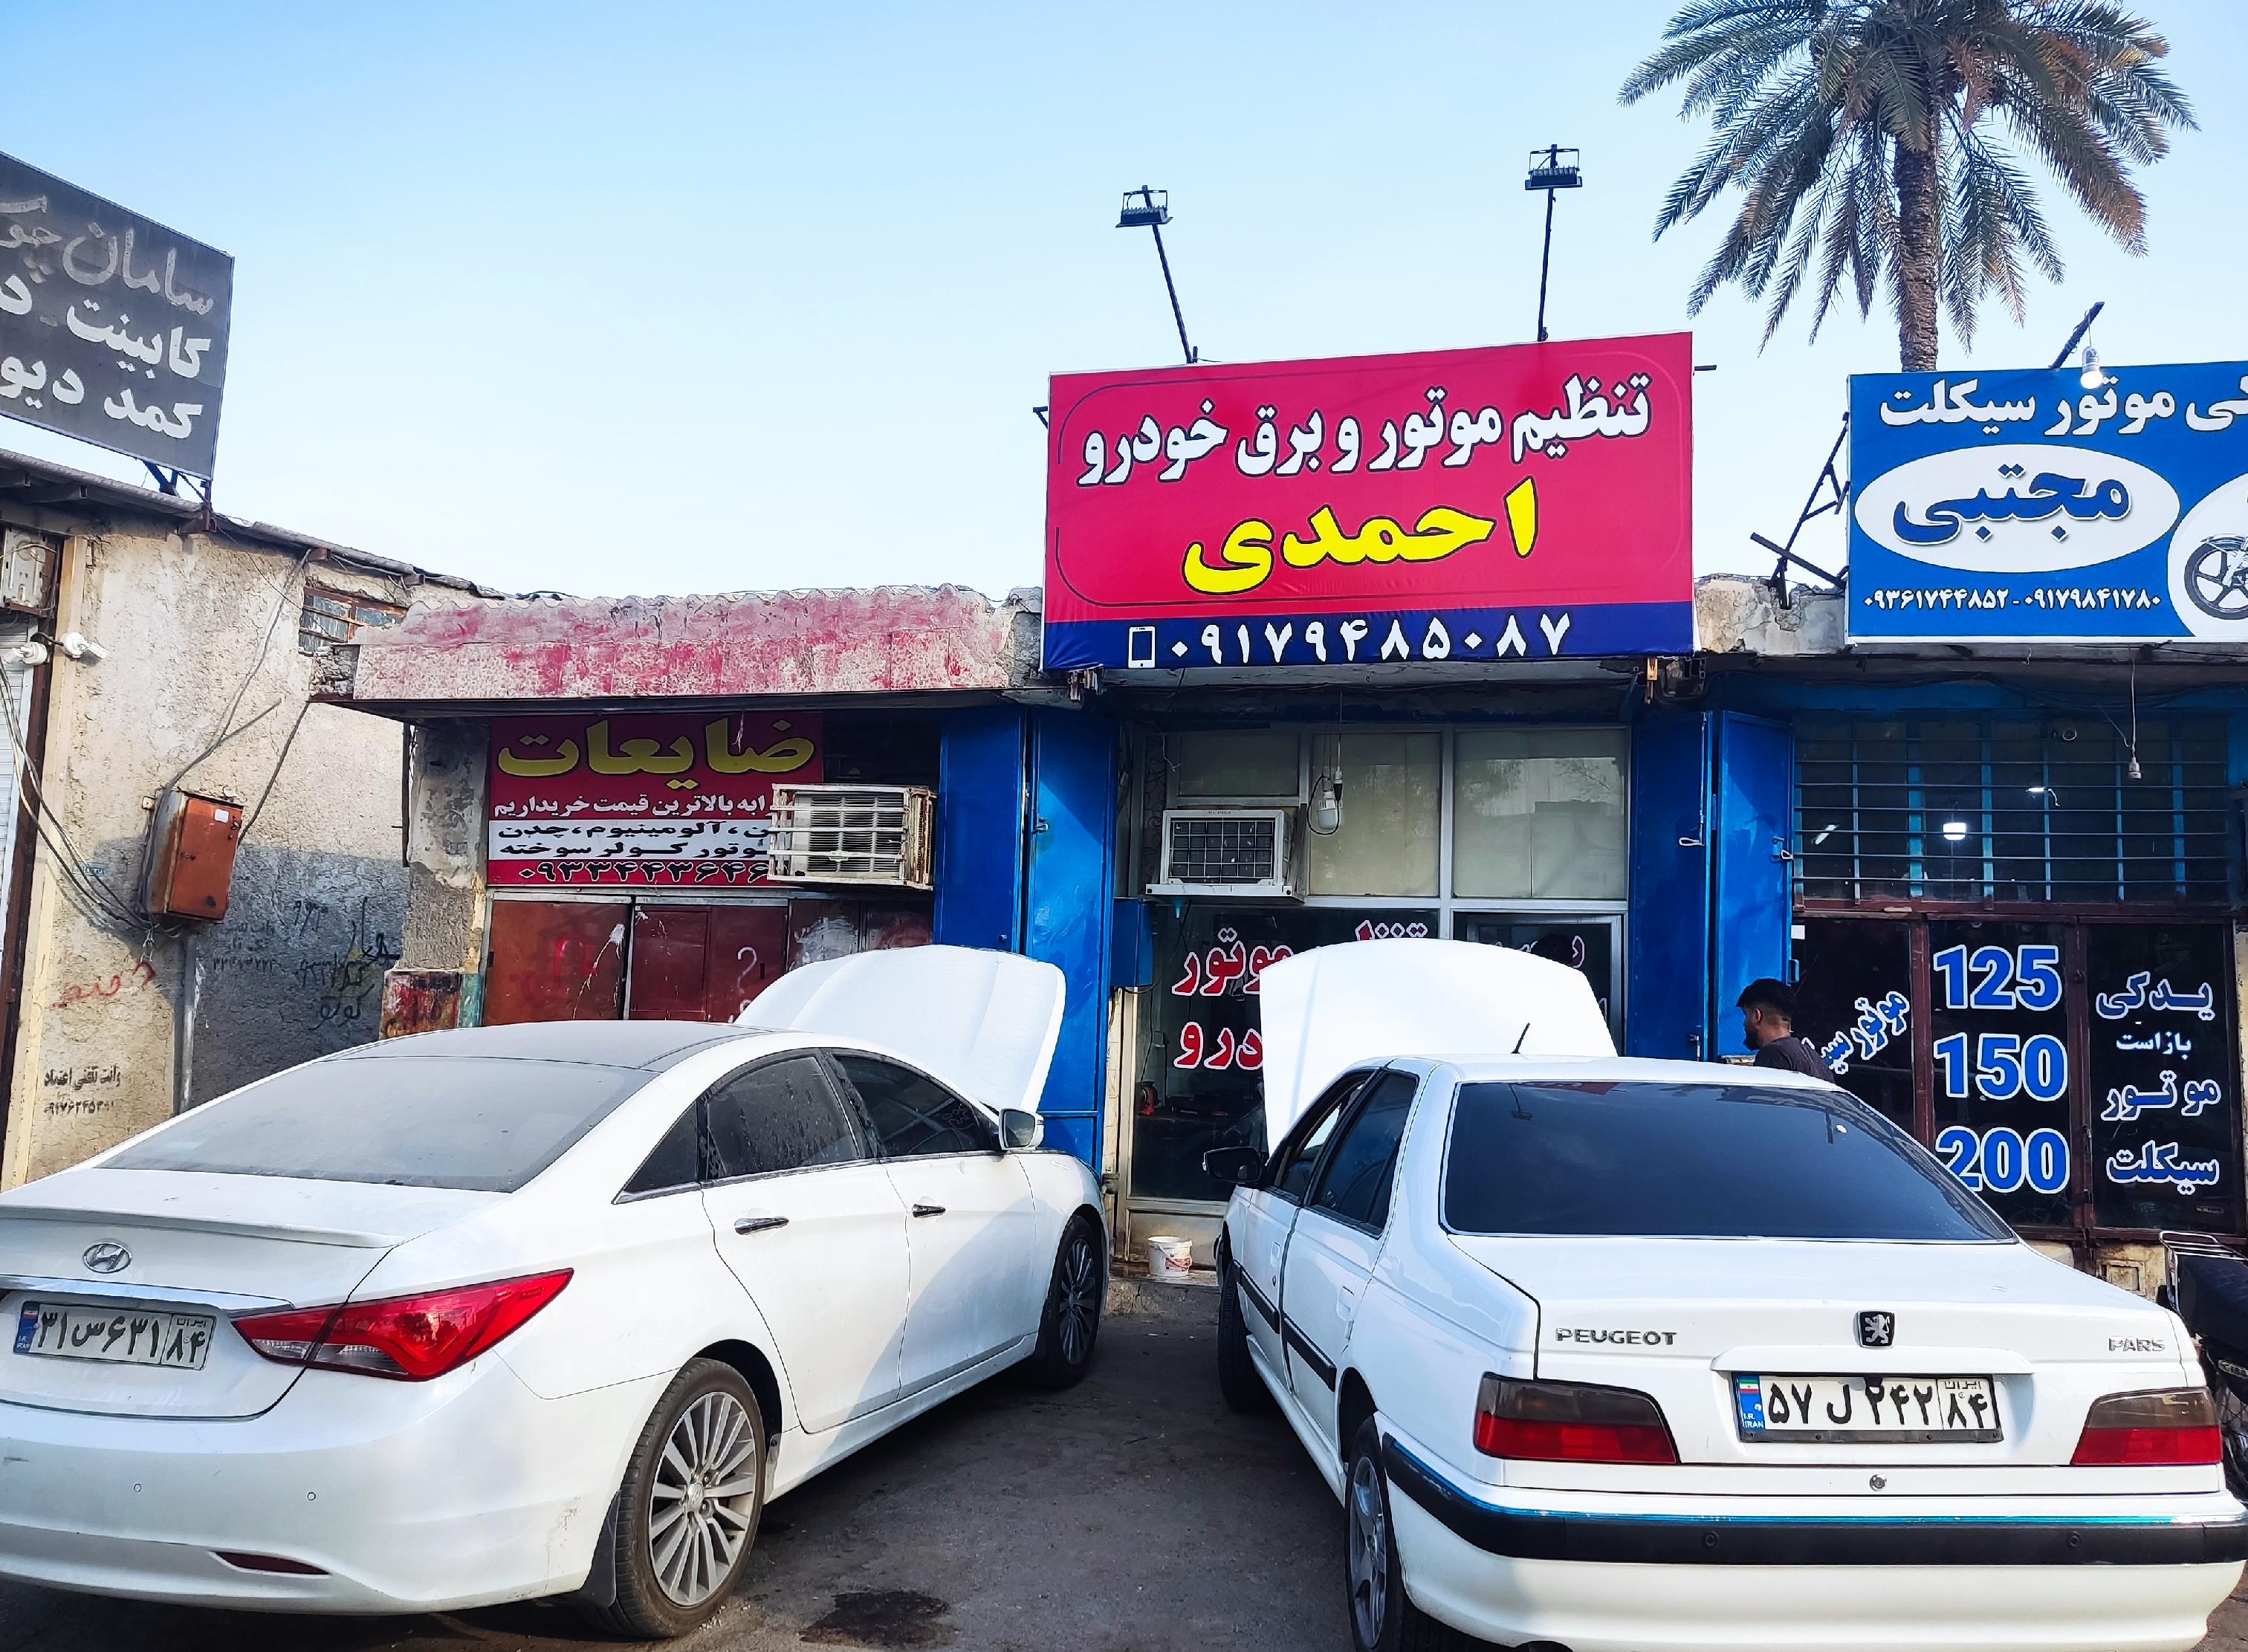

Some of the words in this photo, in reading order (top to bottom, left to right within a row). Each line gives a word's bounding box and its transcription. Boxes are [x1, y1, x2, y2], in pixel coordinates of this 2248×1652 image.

[62, 222, 213, 315] سامان
[66, 299, 211, 378] کابینت
[0, 356, 85, 409] دیو
[1879, 378, 2036, 435] سیکلت
[2044, 375, 2176, 436] موتور
[104, 389, 202, 439] کمد
[1237, 404, 1324, 477] برق
[1368, 386, 1503, 473] موتور
[1513, 372, 1652, 464] تنظیم
[1077, 398, 1229, 486] خودرو
[1330, 420, 1360, 473] و
[1892, 461, 2133, 547] مجتبی
[1182, 477, 1538, 595] احمدی
[1169, 612, 1572, 664] ۰۹۱۷۹۴۸۵۰۸۷
[496, 716, 815, 790] ضایعات
[494, 795, 591, 817] خریداریم
[593, 794, 650, 816] قیمت
[652, 794, 733, 817] بالاترین
[498, 825, 570, 839] چدن
[499, 842, 592, 858] سوخته
[692, 842, 768, 858] وتور
[519, 861, 770, 884] ۰۹۳۳۴۴۳۶۴۶
[1934, 945, 2063, 1011] 125
[2096, 971, 2214, 1021] یدکی
[1173, 1021, 1264, 1069] درو
[1850, 991, 1910, 1060] موتور
[1934, 1032, 2068, 1101] 150
[2101, 1070, 2223, 1121] موتور
[1935, 1126, 2070, 1193] 200
[2105, 1140, 2220, 1195] سیکلت
[166, 1329, 205, 1362] ۸۴
[1556, 1327, 1678, 1345] PEUGEOT
[2108, 1337, 2166, 1352] PARS
[1948, 1393, 1988, 1429] ۸۴
